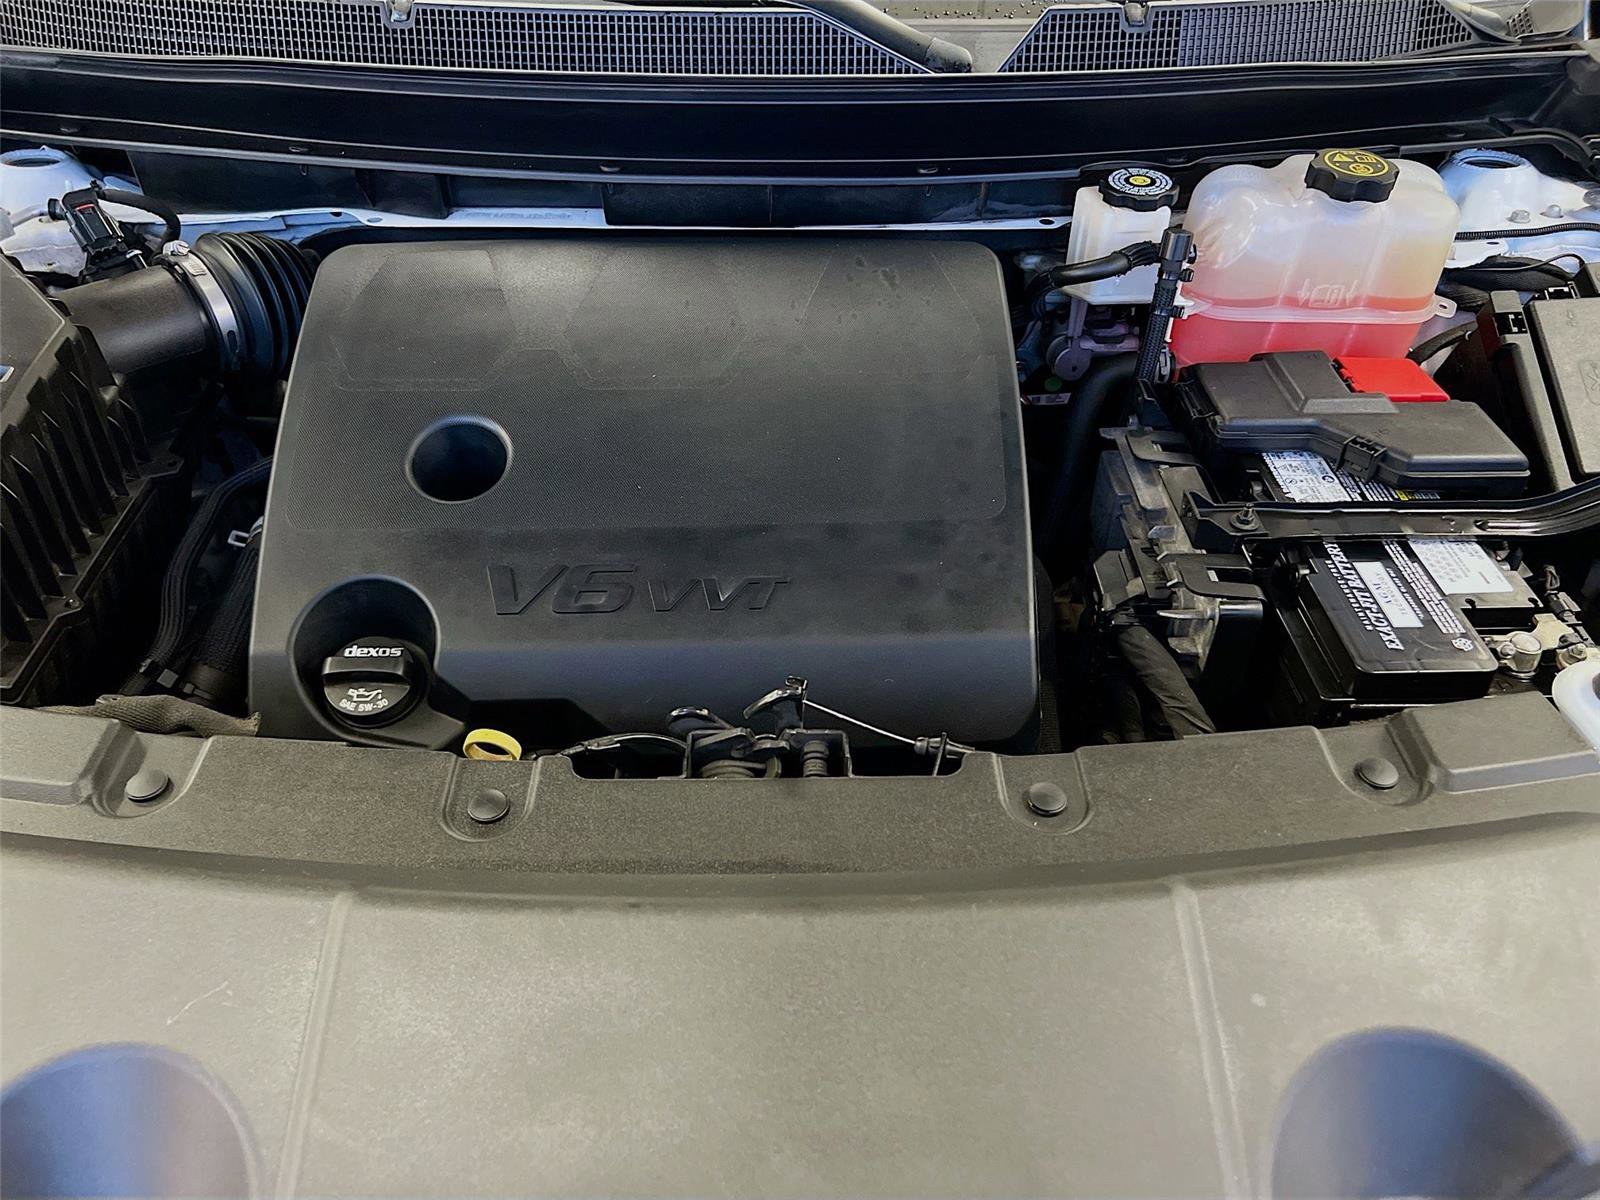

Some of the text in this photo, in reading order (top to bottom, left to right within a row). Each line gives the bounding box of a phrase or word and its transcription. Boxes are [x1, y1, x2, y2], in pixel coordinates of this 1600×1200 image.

[487, 564, 793, 615] V6 VVT
[1324, 543, 1366, 590] BATTERY
[1352, 589, 1405, 650] EXACT-FIT
[344, 645, 404, 657] dexos
[340, 699, 389, 712] SAE 5W-30
